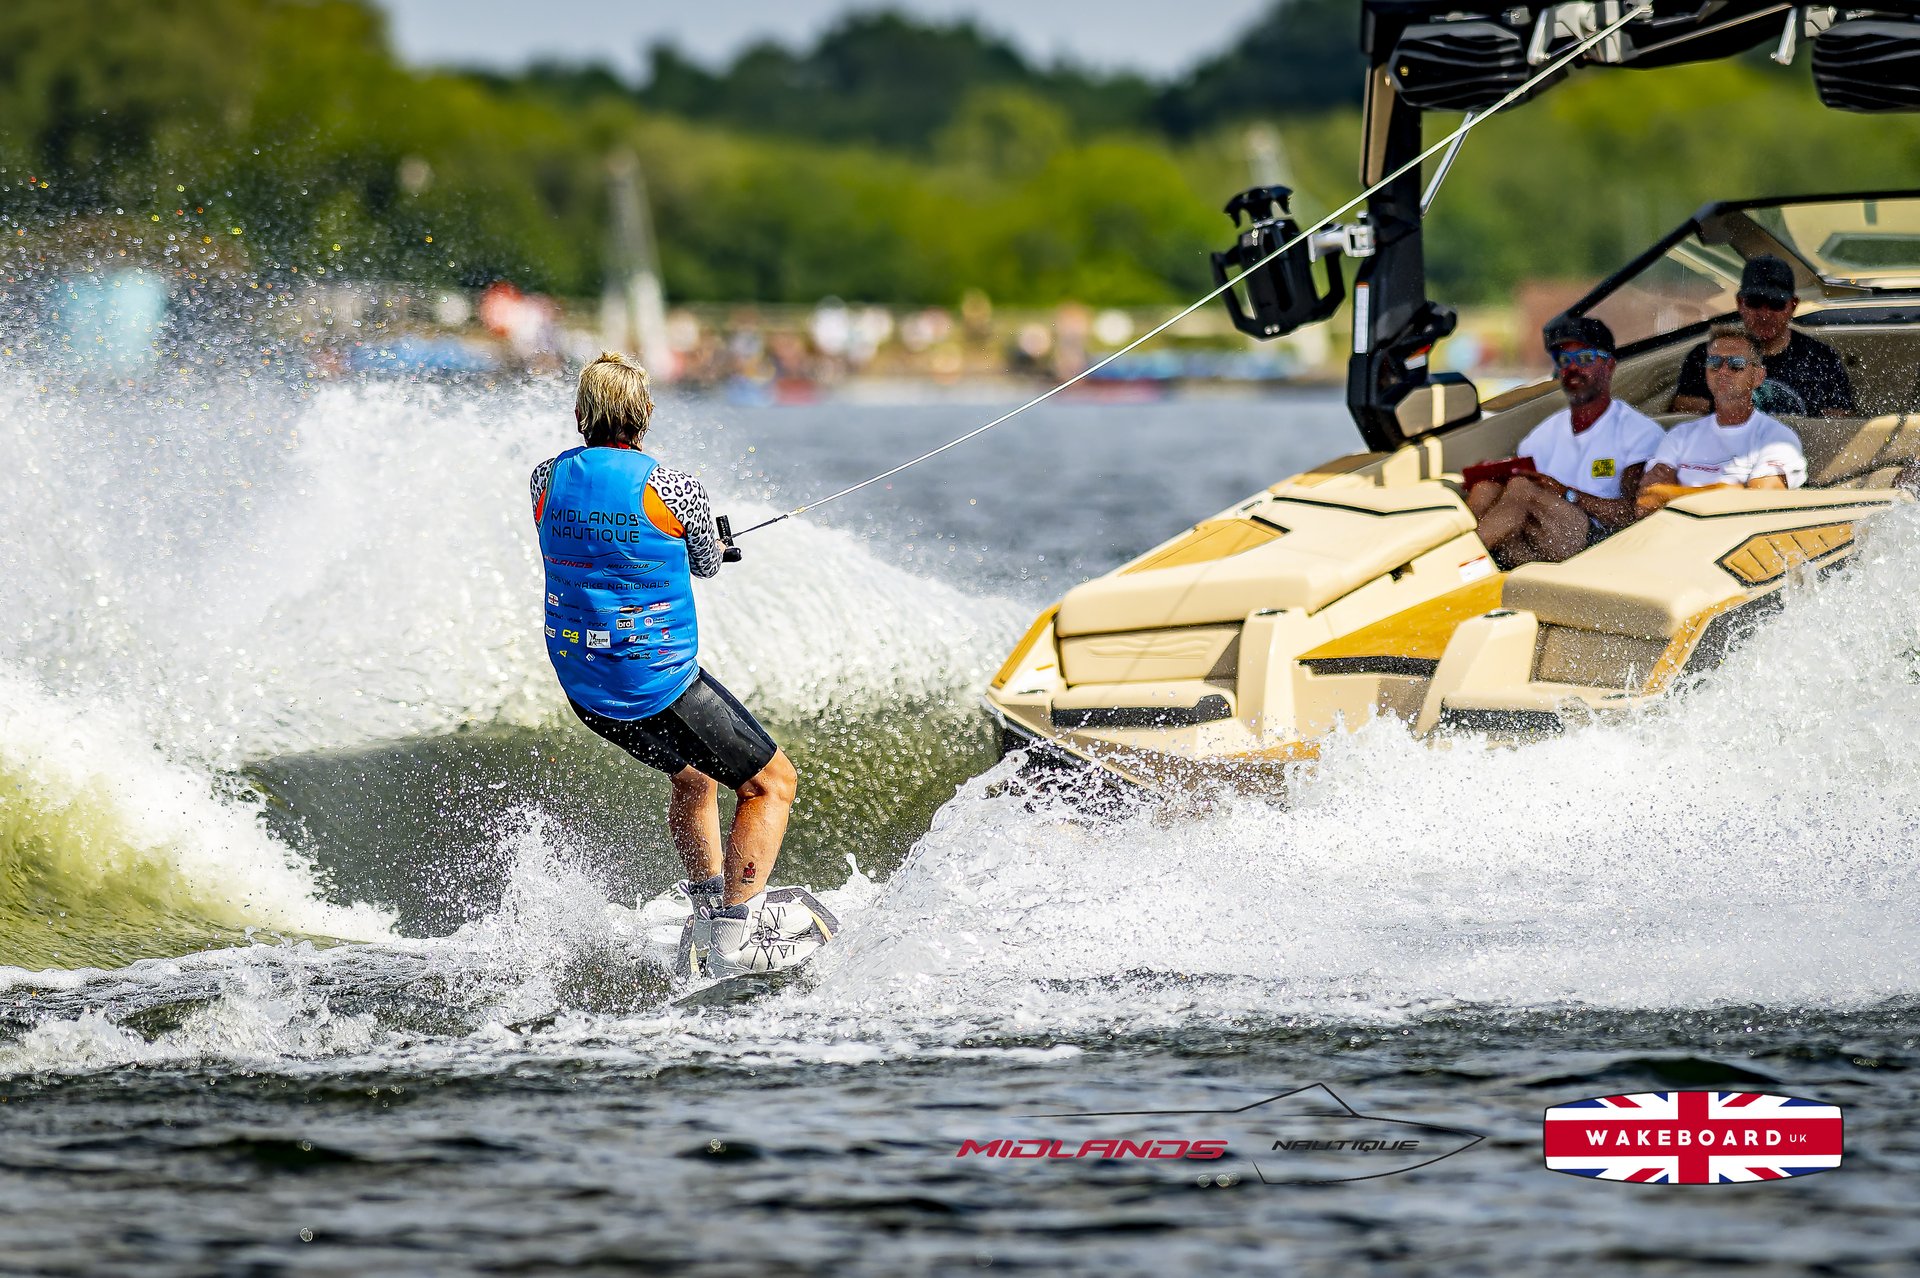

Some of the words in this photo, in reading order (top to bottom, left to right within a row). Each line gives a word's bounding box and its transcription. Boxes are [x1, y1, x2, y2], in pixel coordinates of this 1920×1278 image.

[551, 509, 639, 527] MIDLANDS
[551, 525, 640, 544] NAUTIQUE
[574, 581, 603, 589] WAKE
[607, 580, 670, 591] NATIONALS
[562, 629, 579, 640] C4
